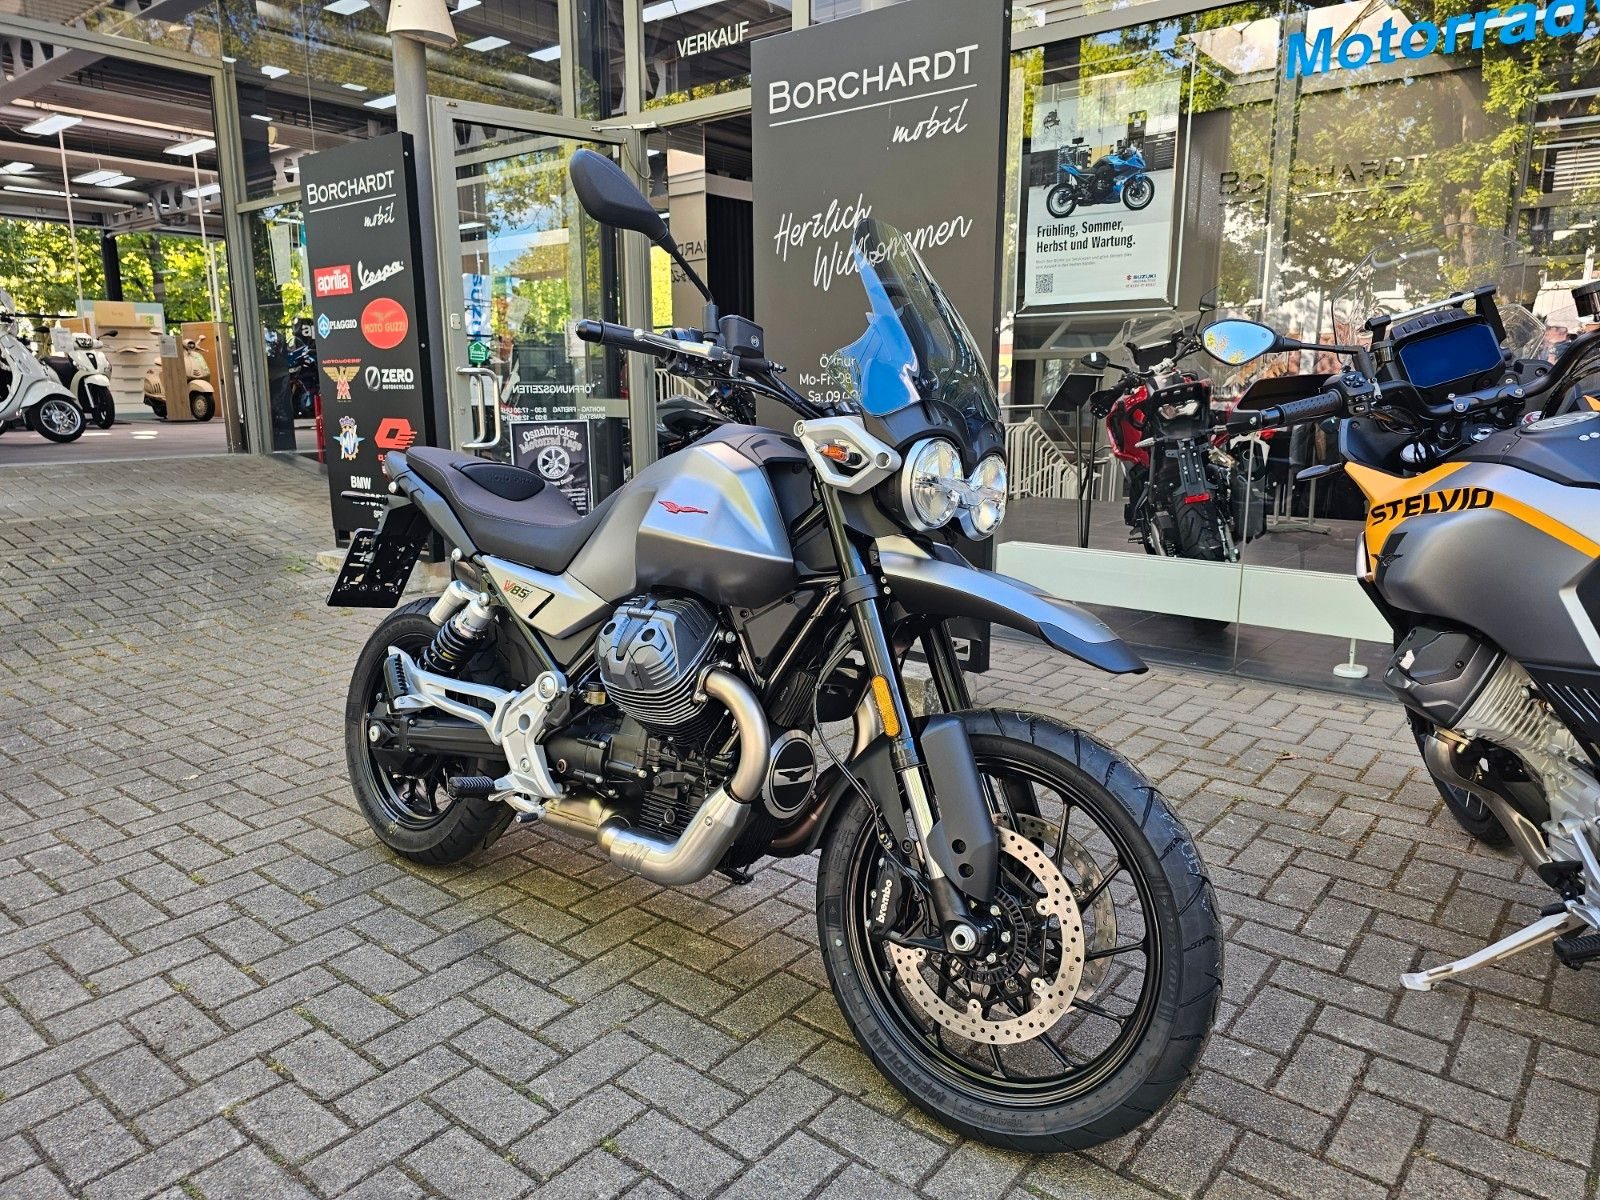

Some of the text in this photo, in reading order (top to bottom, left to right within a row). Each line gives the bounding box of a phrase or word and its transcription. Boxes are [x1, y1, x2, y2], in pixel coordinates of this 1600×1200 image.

[677, 21, 749, 58] VERKAUF
[769, 44, 979, 114] BORCHARDT
[892, 98, 969, 143] mobil
[306, 169, 395, 205] BORCHARDT
[364, 202, 395, 227] mobil
[774, 193, 872, 262] Herzlich
[1036, 220, 1124, 238] Frühling, Sommer,
[1036, 234, 1136, 253] Herbst und Wartung.
[317, 269, 349, 294] aprilia
[357, 260, 404, 291] Vespa
[329, 319, 357, 330] PIAGGIO
[365, 323, 382, 333] MOTO
[381, 368, 414, 383] ZERO
[522, 425, 579, 441] Osnabrücker
[562, 436, 583, 452] Tage
[350, 475, 371, 490] BMW
[1370, 487, 1495, 526] STELVIO
[876, 879, 893, 924] brembo
